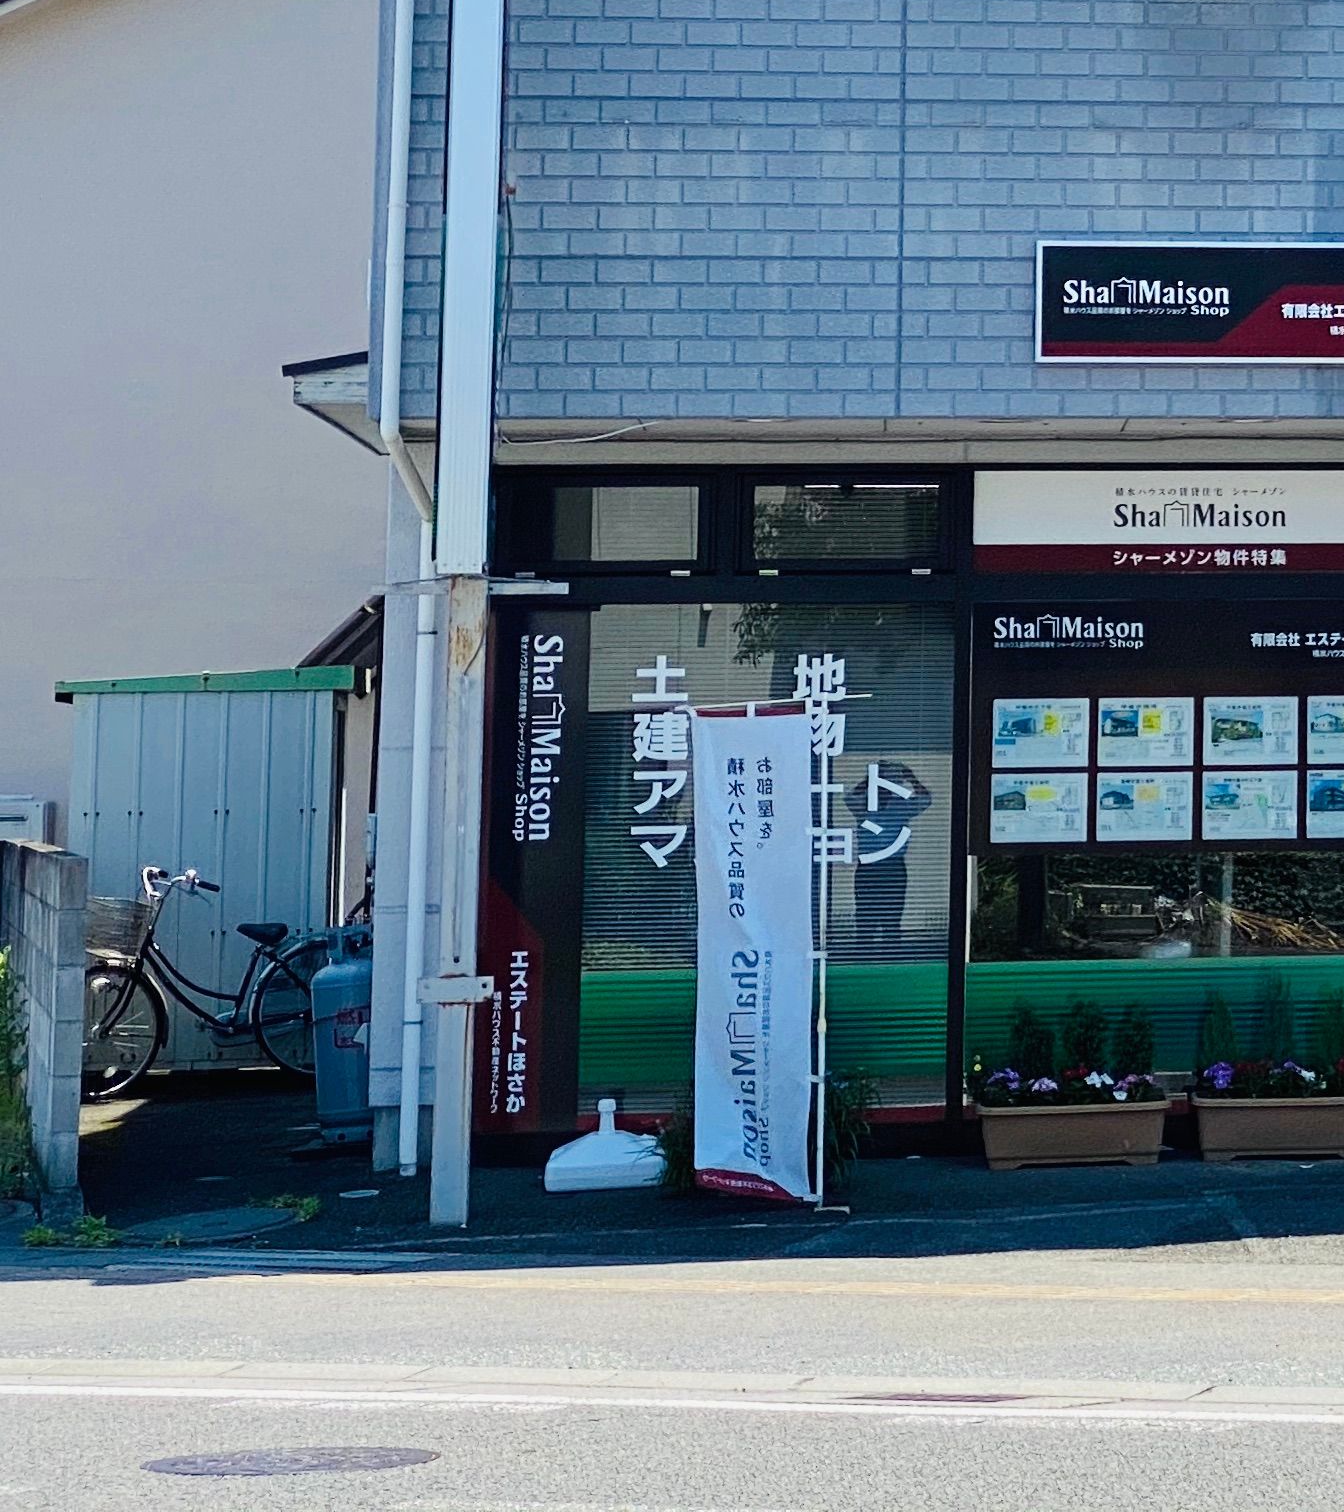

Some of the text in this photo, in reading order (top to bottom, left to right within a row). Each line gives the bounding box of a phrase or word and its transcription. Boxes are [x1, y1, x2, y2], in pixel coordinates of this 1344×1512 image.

[1190, 305, 1229, 317] Shop
[1113, 549, 1287, 566] シャーメゾン物件特集
[1109, 638, 1144, 649] Shop
[1250, 632, 1300, 647] 有限会社
[512, 793, 528, 842] Shop
[506, 951, 529, 1113] エステートほさか
